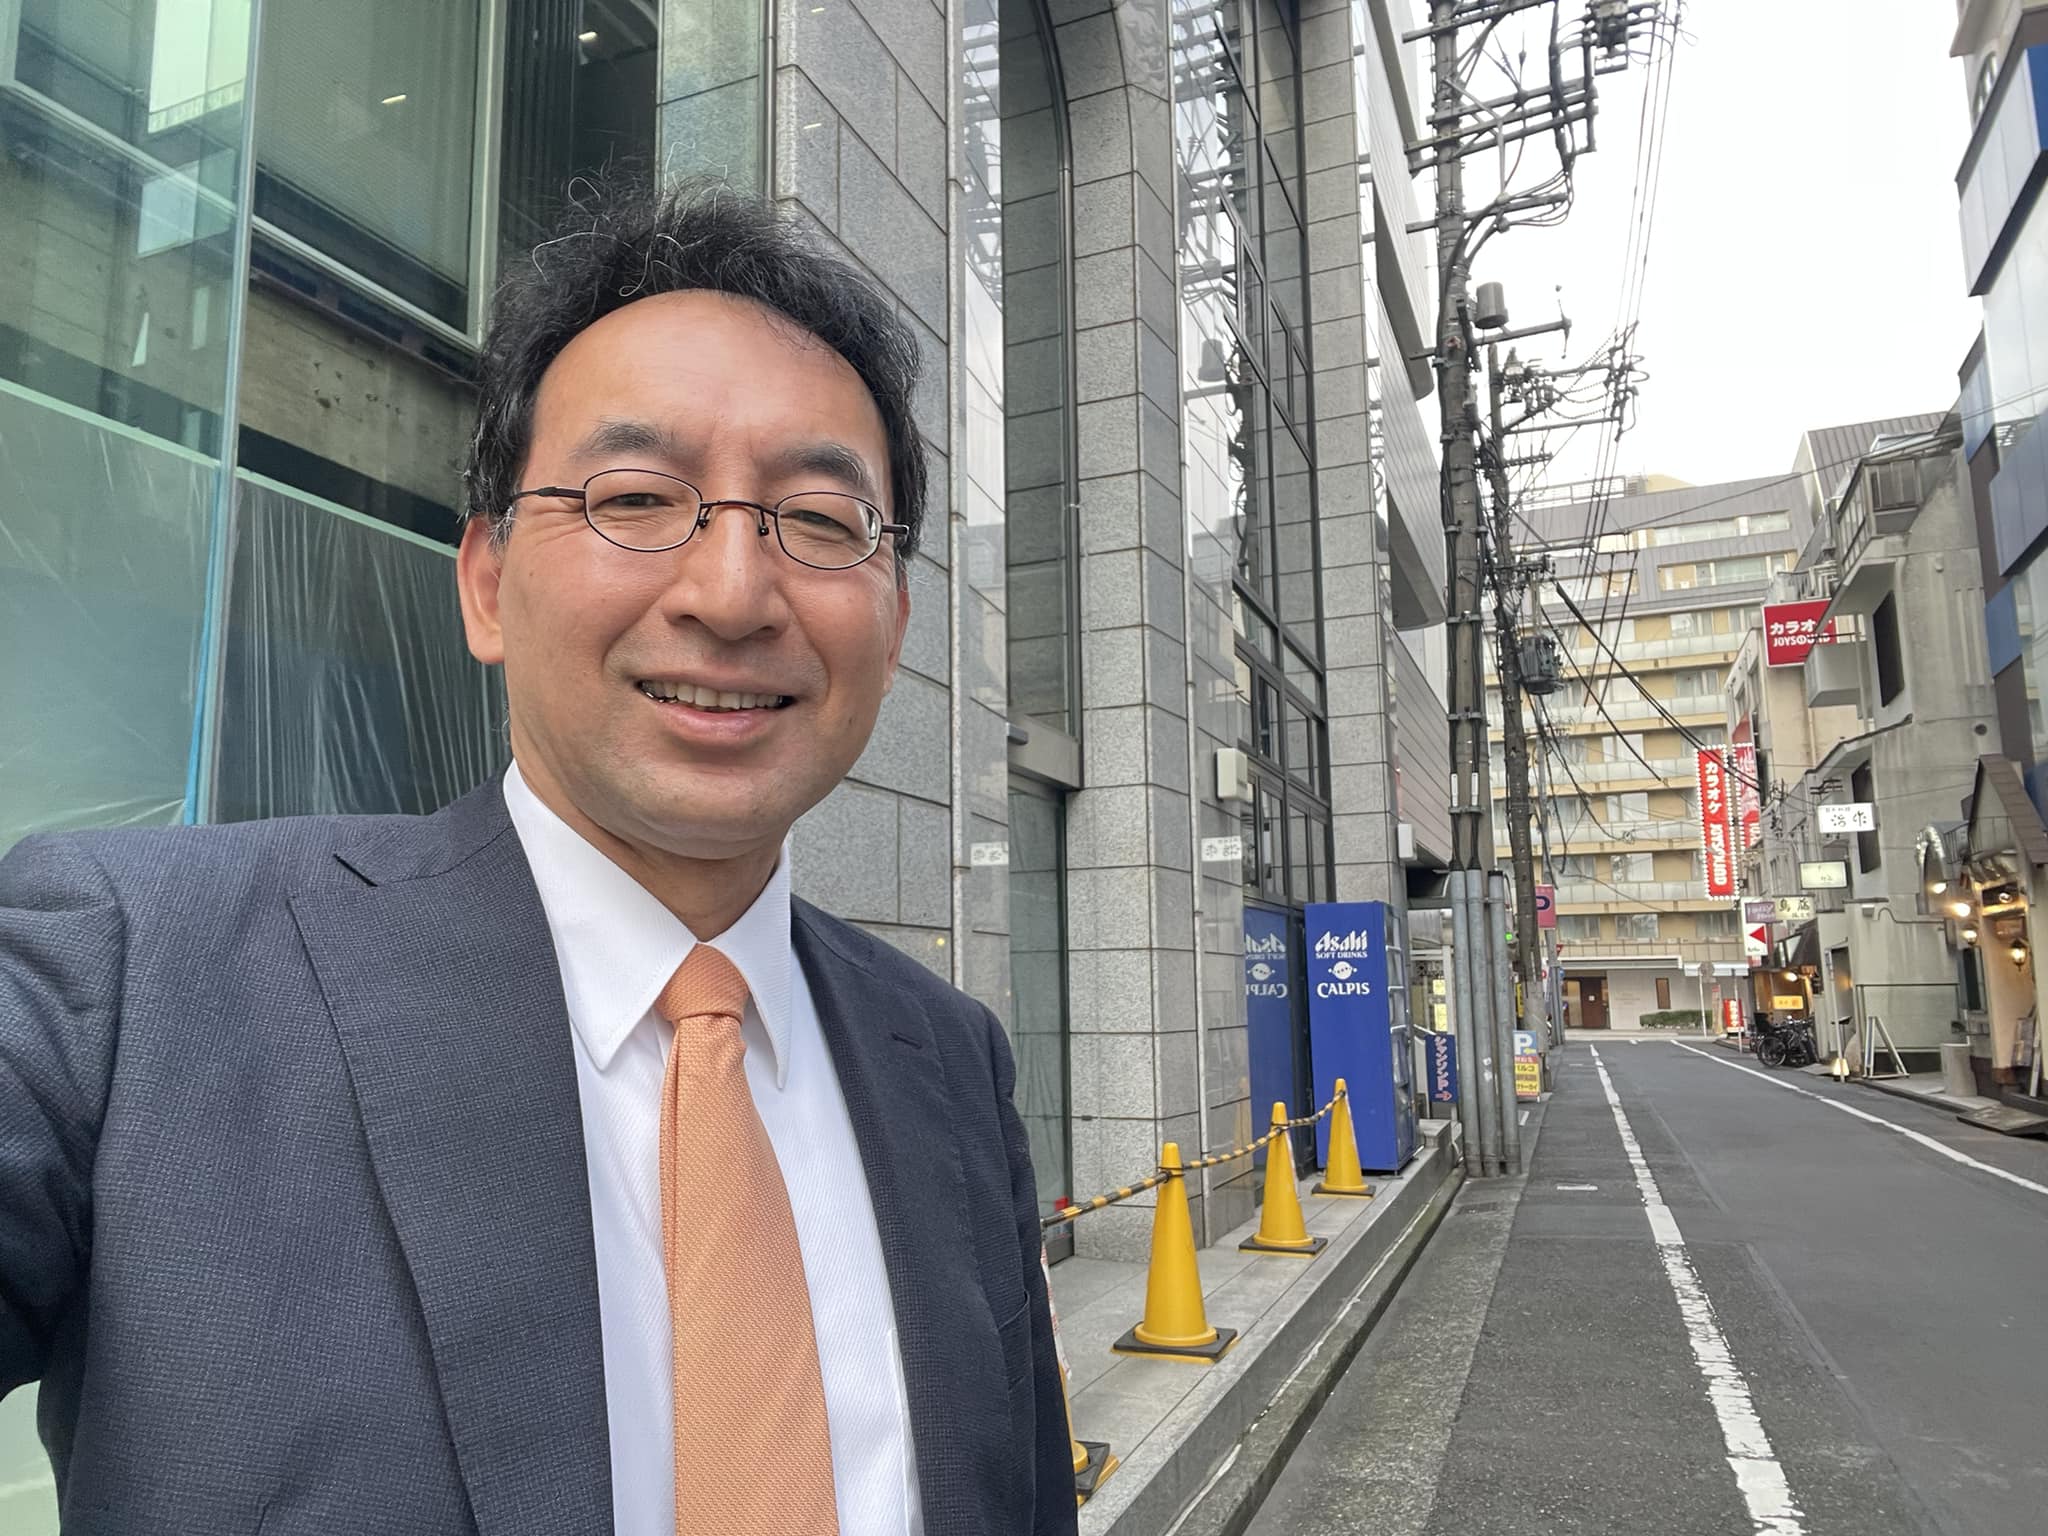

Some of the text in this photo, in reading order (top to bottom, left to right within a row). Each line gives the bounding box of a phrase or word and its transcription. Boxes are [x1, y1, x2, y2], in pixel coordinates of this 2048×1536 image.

[1770, 618, 1832, 636] カラオ
[1705, 761, 1722, 814] カラオケ
[1315, 929, 1368, 952] Asahi
[1315, 951, 1368, 959] SOFT DRINKS
[1317, 982, 1370, 998] CALPIS
[1514, 1033, 1533, 1055] P
